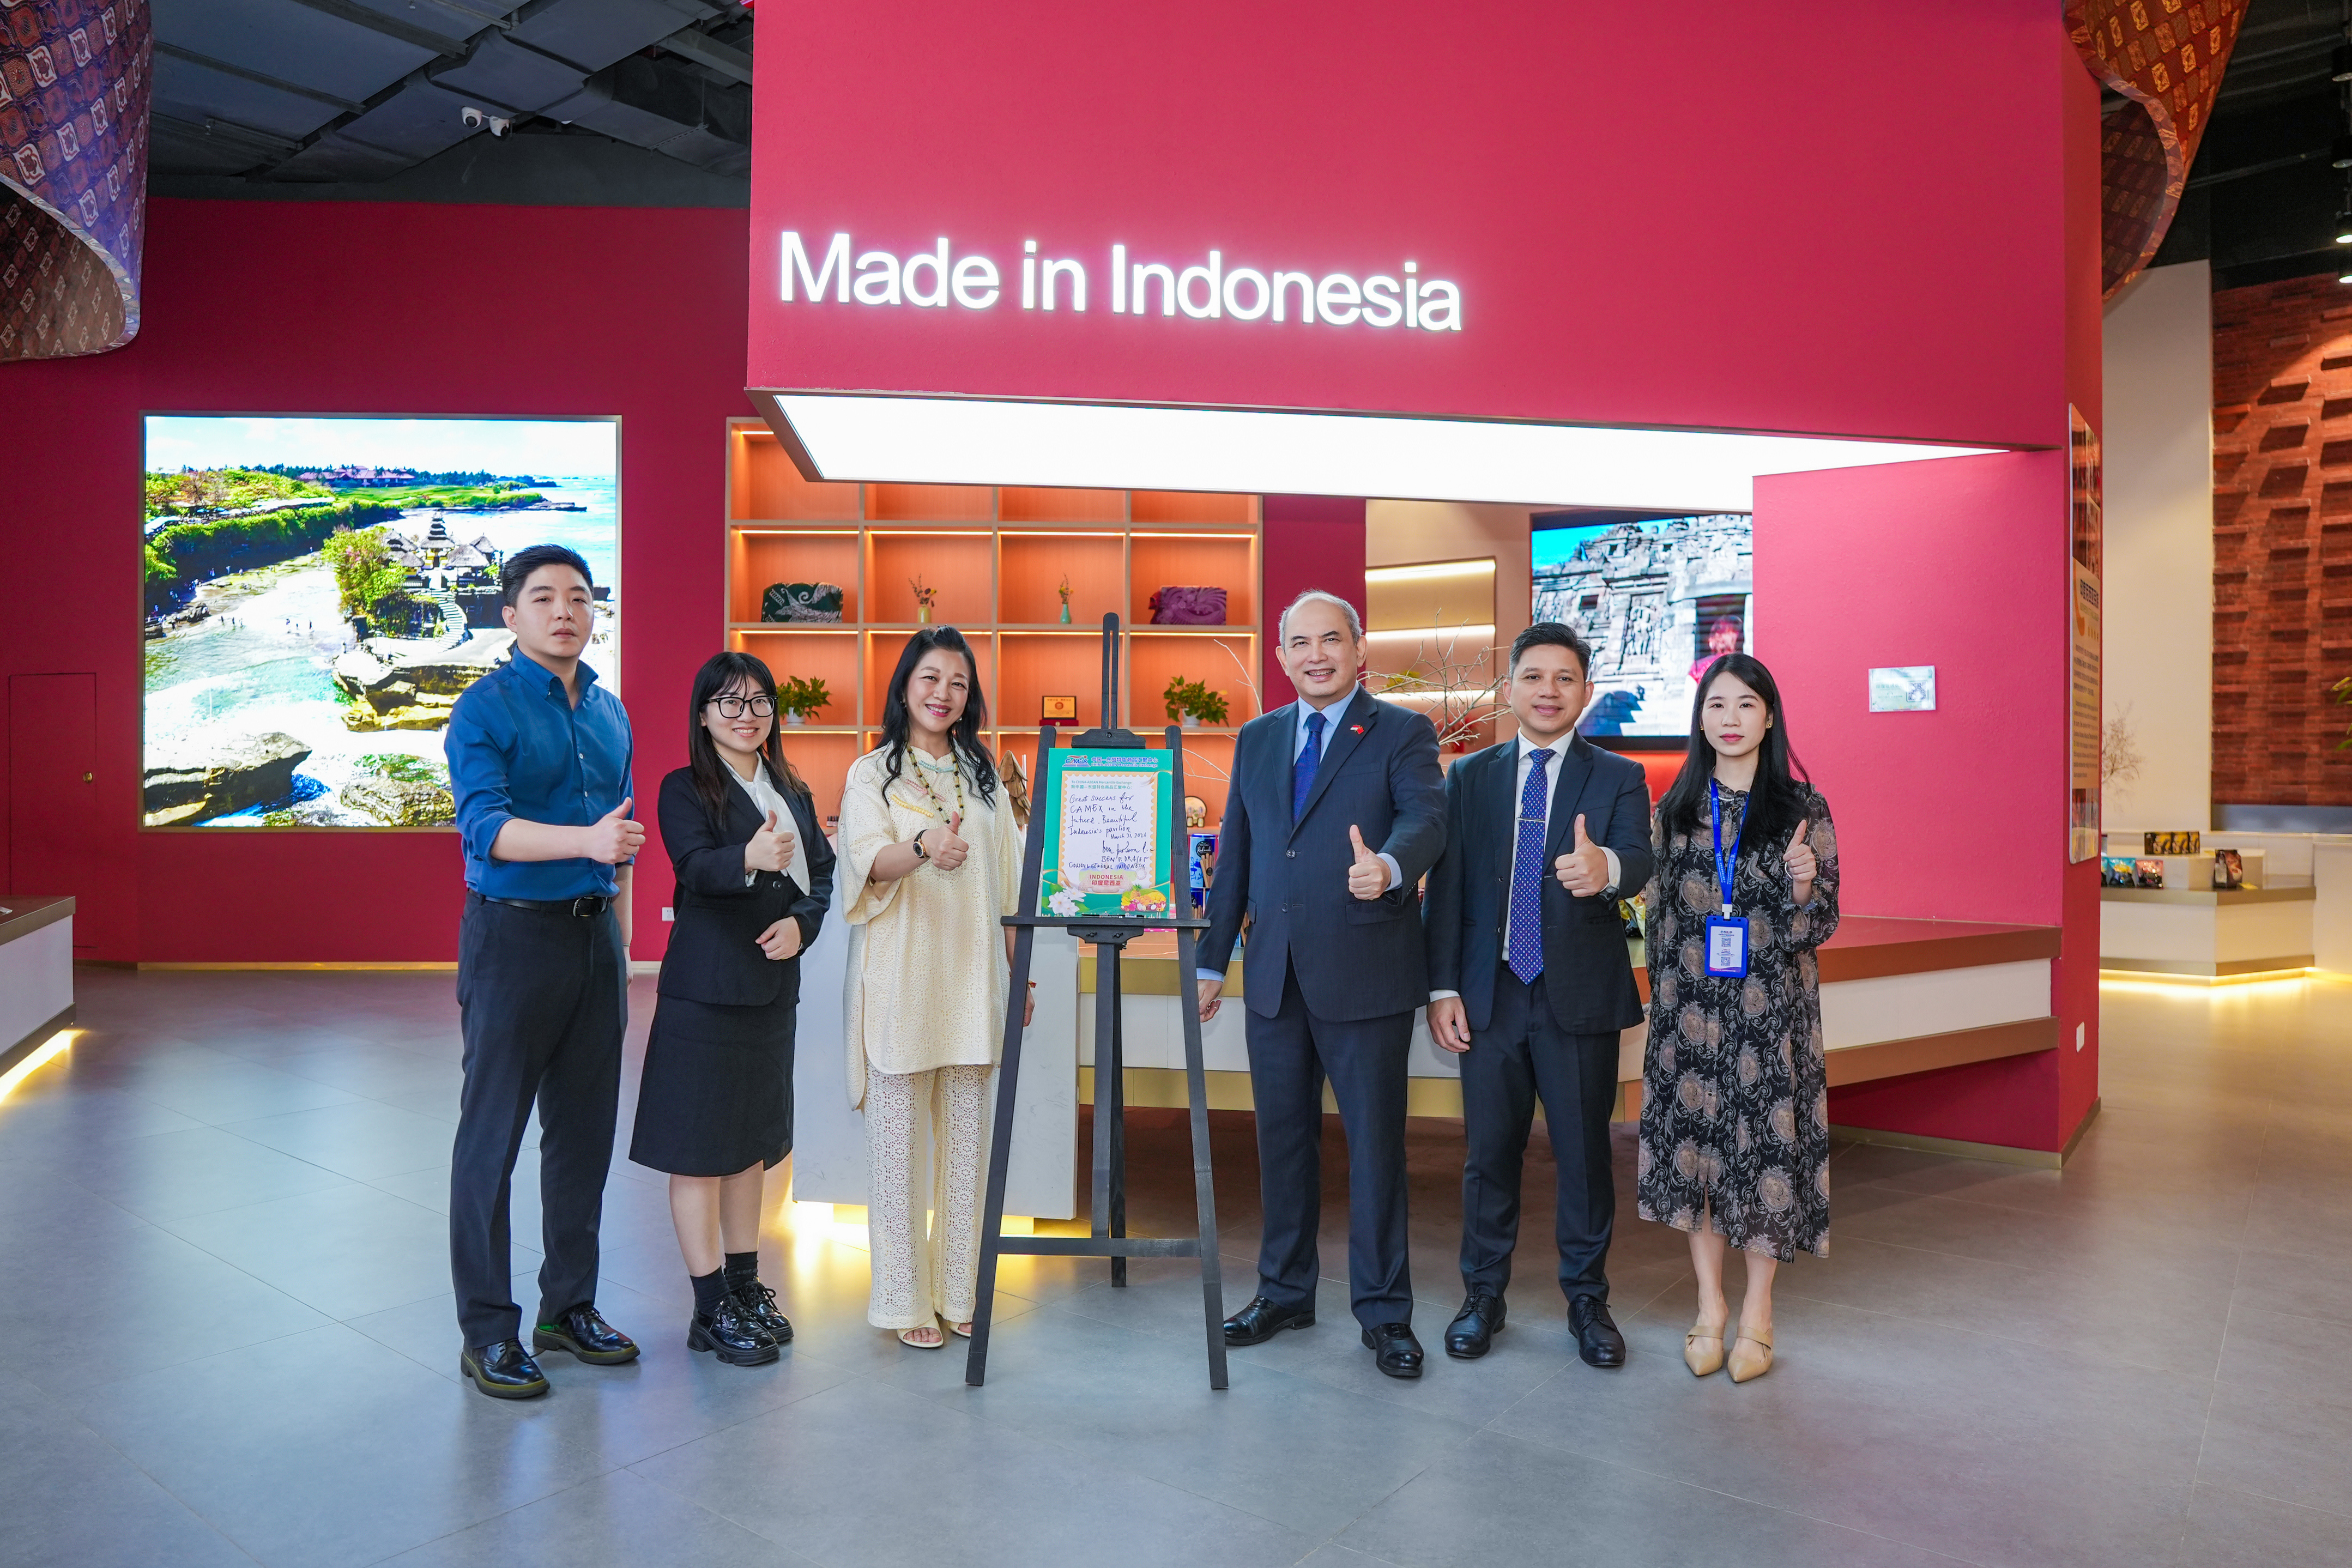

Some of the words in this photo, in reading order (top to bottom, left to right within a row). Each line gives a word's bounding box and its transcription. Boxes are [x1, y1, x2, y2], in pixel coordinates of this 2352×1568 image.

[779, 231, 1000, 310] Made
[1023, 240, 1086, 313] in
[1112, 244, 1463, 331] Indonesia
[1069, 794, 1089, 803] Great
[1120, 792, 1134, 803] for
[1106, 824, 1131, 837] pavilion
